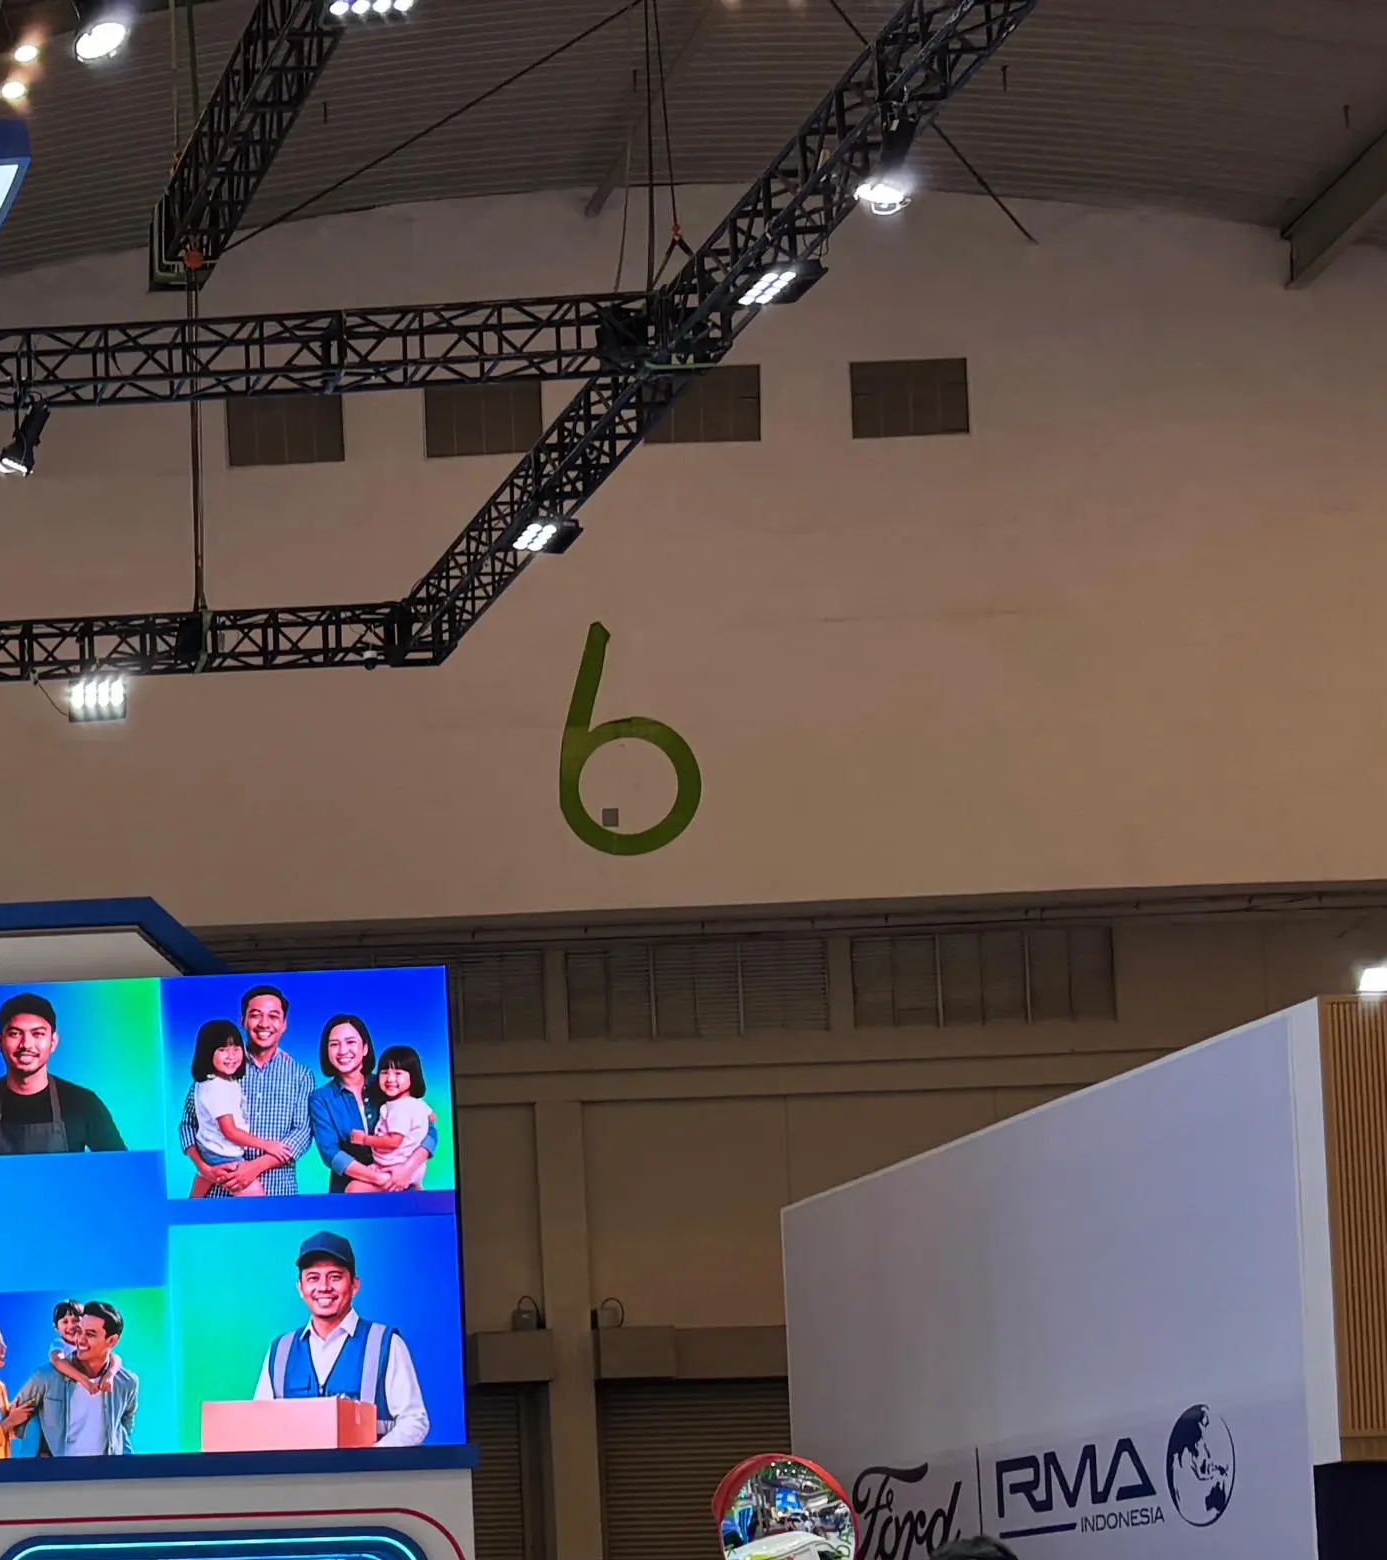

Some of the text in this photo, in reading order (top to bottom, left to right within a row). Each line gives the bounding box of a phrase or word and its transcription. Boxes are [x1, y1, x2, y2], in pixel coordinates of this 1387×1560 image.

[559, 621, 702, 856] 6
[995, 1437, 1157, 1518] RMA
[1080, 1506, 1165, 1533] INDONESIA
